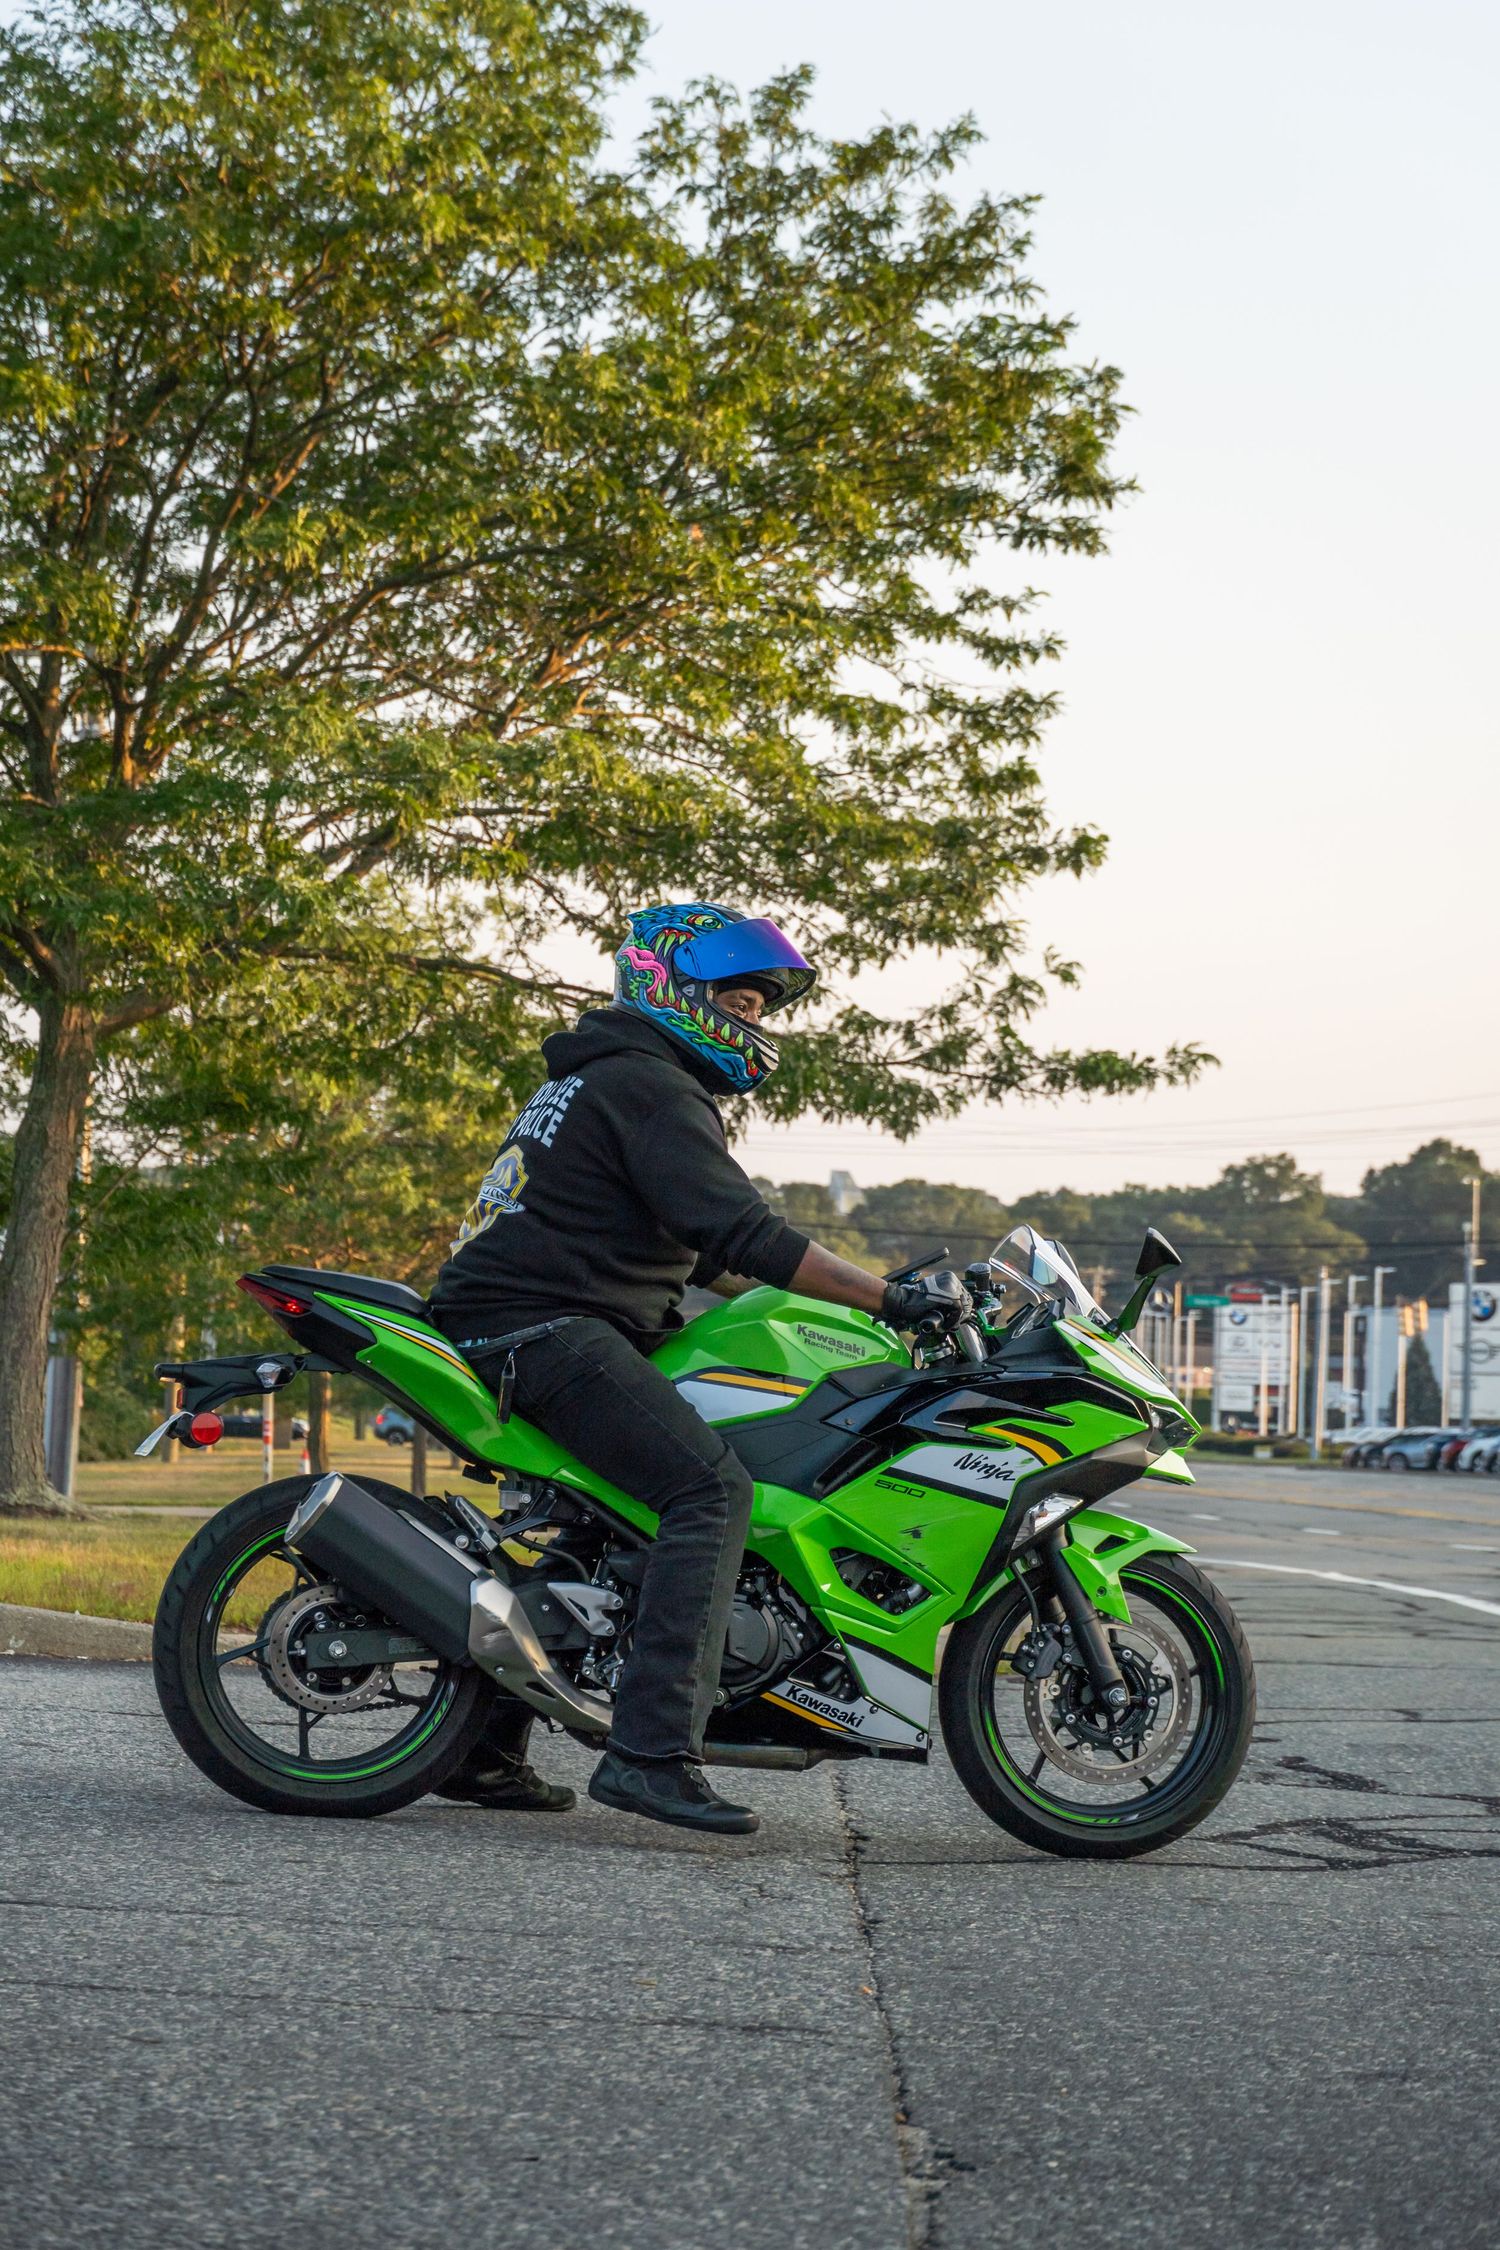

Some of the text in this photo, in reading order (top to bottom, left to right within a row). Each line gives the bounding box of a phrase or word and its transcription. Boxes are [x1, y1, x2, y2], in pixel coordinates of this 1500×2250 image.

[510, 1106, 564, 1149] POLICE
[797, 1324, 865, 1357] Kawasaki
[804, 1338, 857, 1361] Racing Team
[953, 1452, 1016, 1481] Ninja
[874, 1479, 926, 1498] 500
[785, 1685, 865, 1728] Kawasaki
